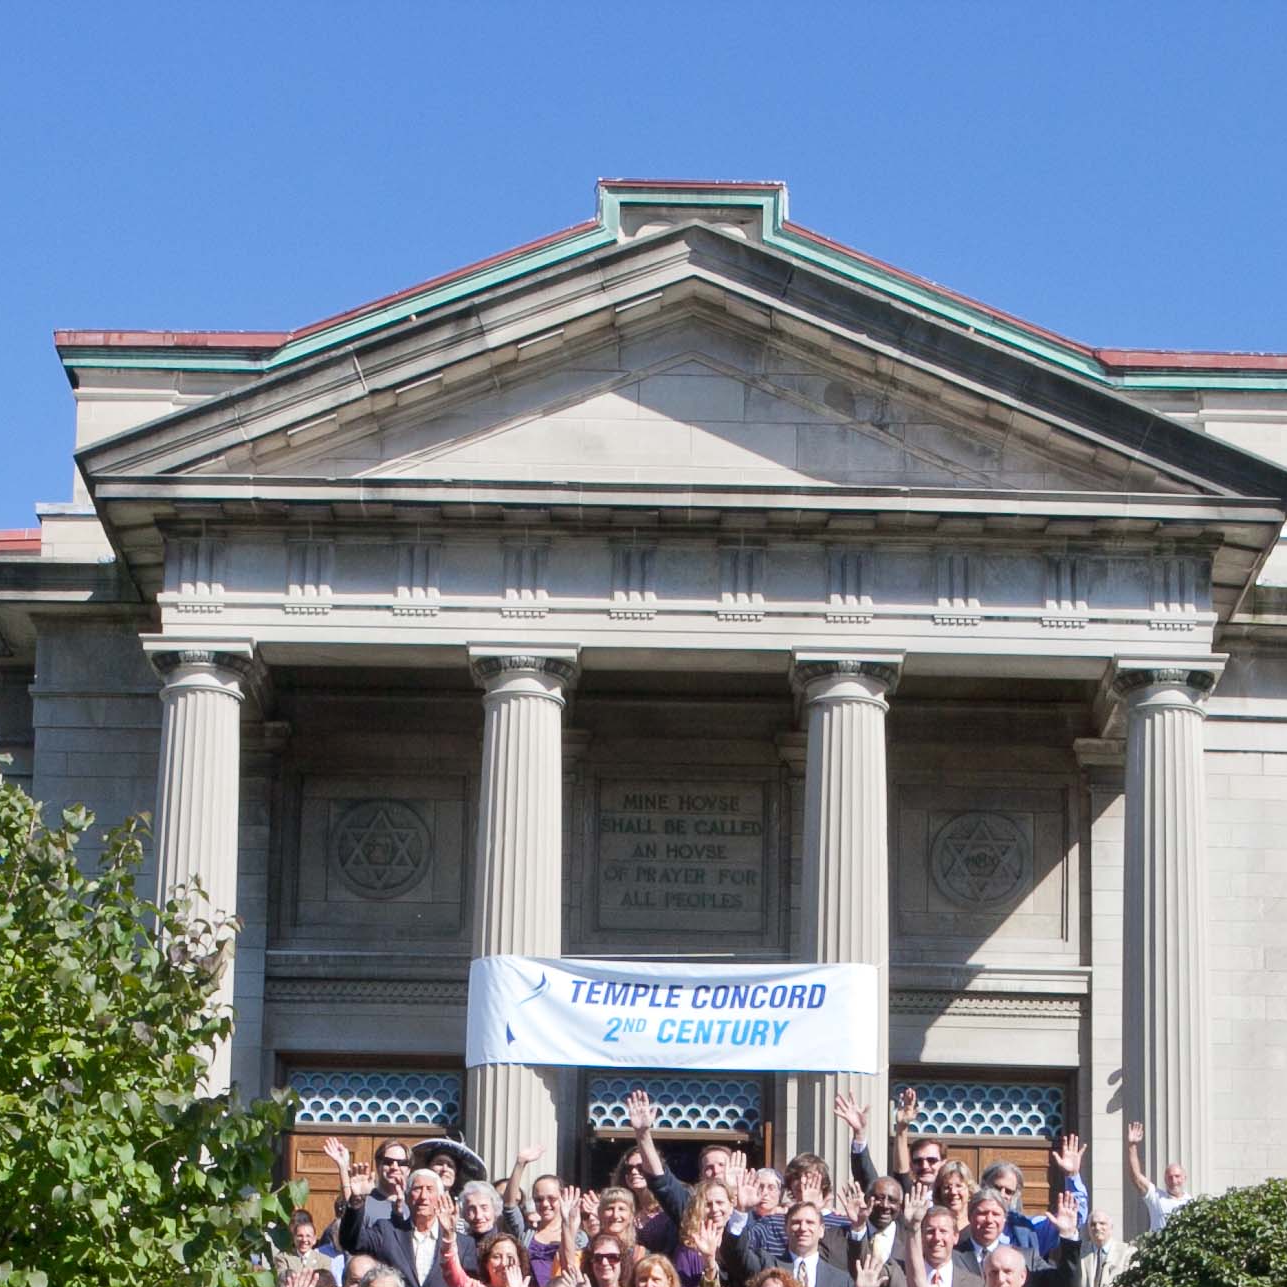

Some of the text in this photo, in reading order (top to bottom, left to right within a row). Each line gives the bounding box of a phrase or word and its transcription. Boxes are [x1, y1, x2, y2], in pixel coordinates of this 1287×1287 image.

[623, 794, 670, 809] MINE
[600, 818, 762, 836] SHALL BE CALLED
[632, 843, 657, 858] AN
[604, 866, 757, 885] OF PRAYER FOR
[620, 891, 743, 908] ALL PEOPLES
[570, 979, 826, 1009] TEMPLE CONCORD
[603, 1017, 789, 1046] 2ND CENTURY
